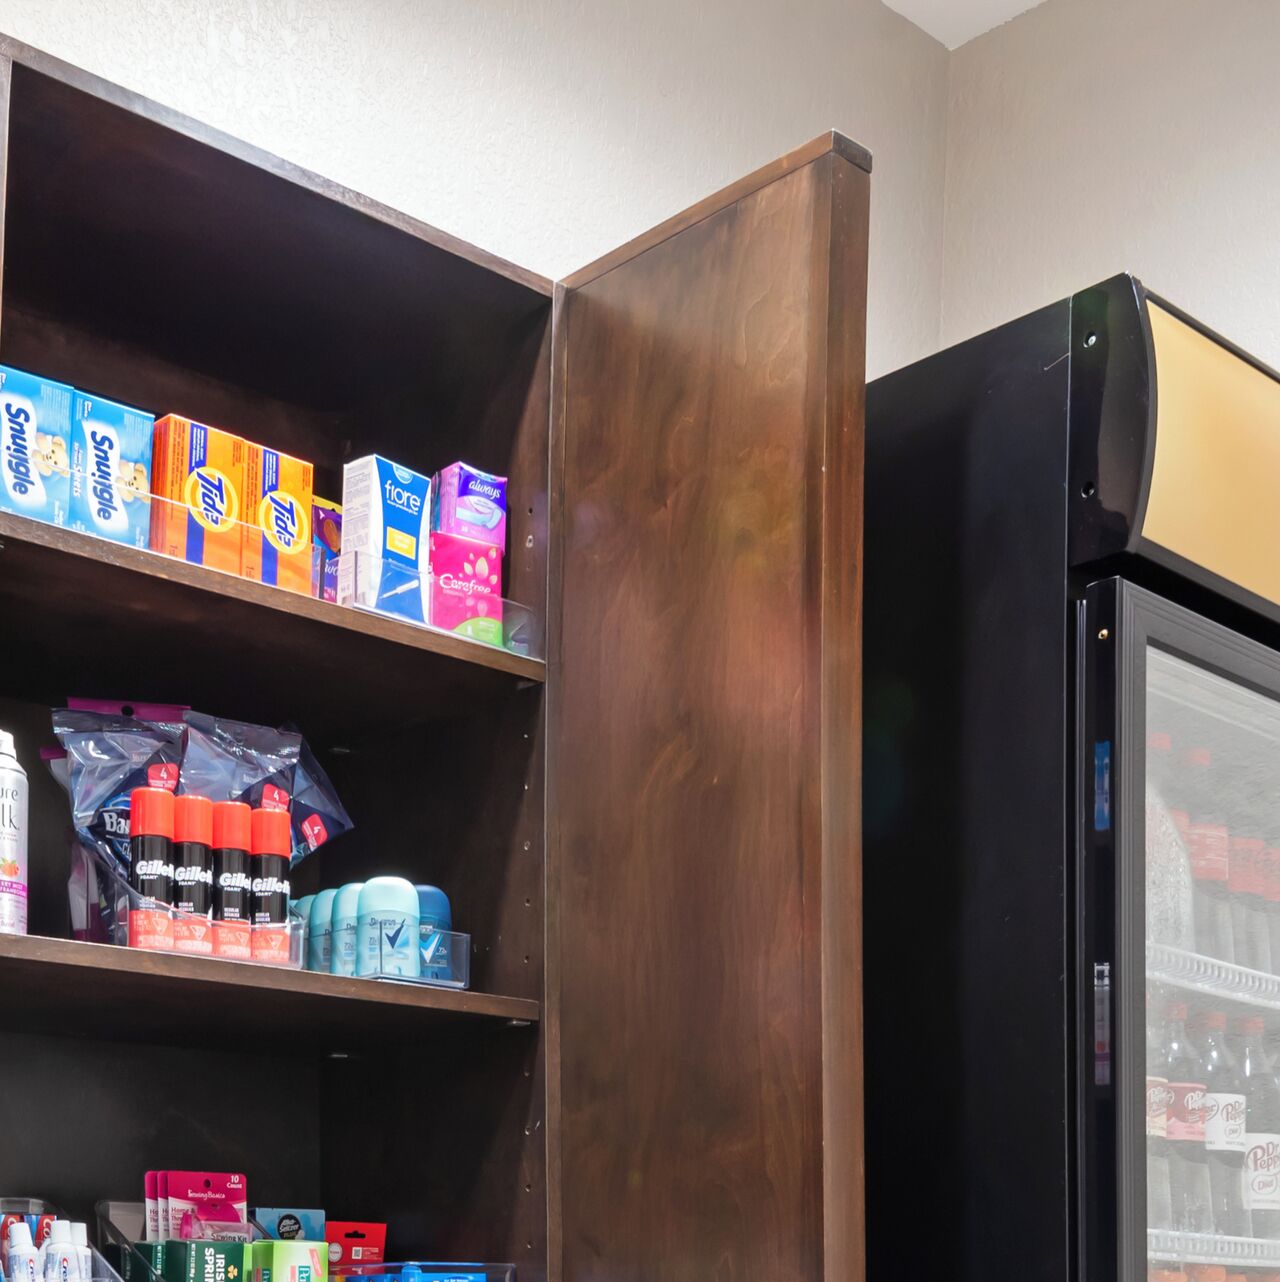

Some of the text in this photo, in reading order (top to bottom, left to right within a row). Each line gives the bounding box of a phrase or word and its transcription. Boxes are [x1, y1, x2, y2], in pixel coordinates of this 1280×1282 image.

[5, 402, 35, 495] Snuggle
[91, 430, 118, 520] Snuggle
[196, 471, 225, 526] Tide
[384, 480, 421, 512] fiore
[469, 479, 502, 500] always
[269, 495, 296, 548] Tide
[160, 769, 167, 779] 4
[1266, 1142, 1279, 1155] Dr
[231, 1175, 239, 1183] 10
[237, 1234, 247, 1242] Kit
